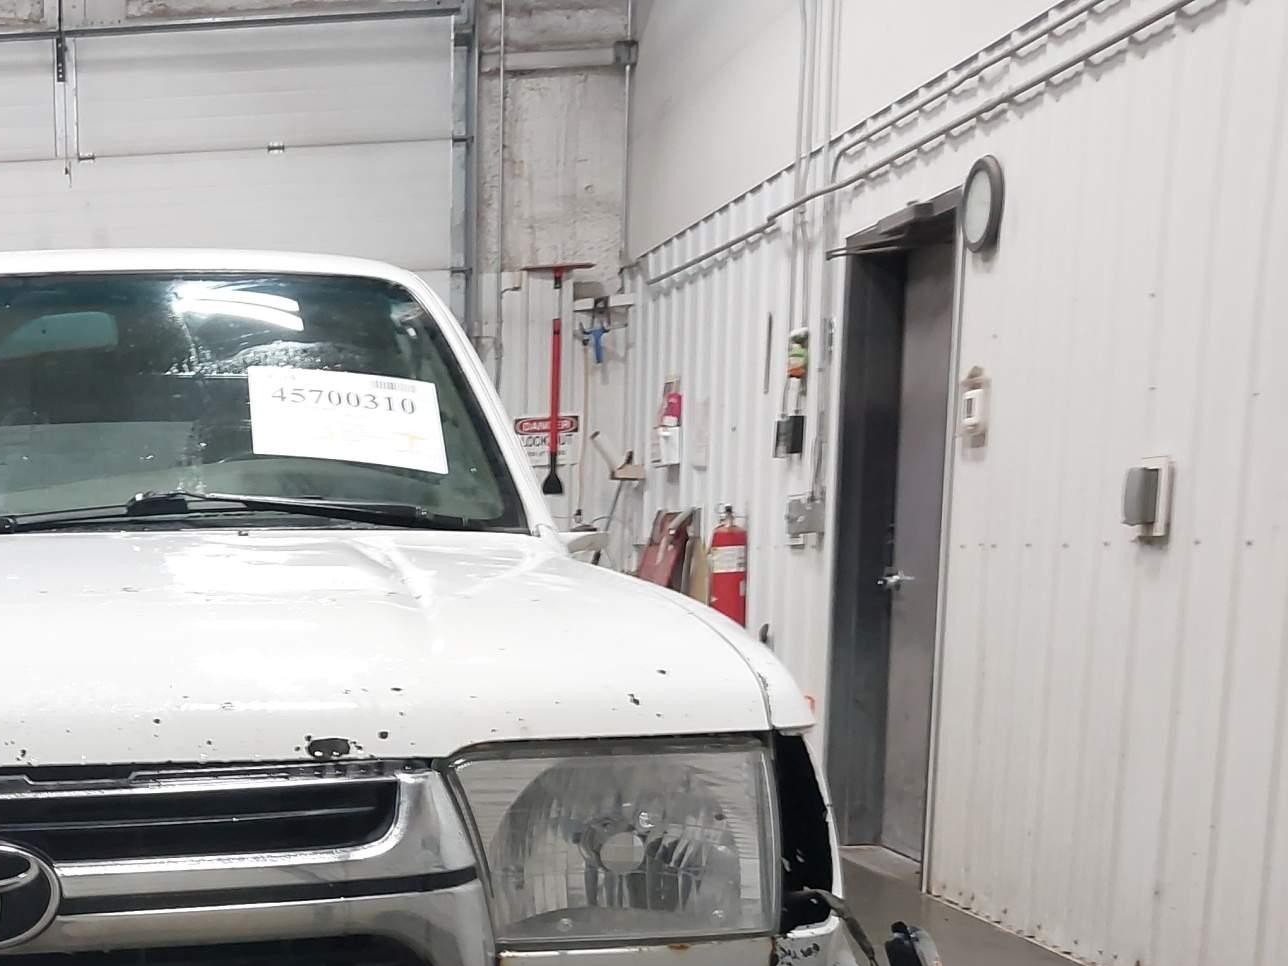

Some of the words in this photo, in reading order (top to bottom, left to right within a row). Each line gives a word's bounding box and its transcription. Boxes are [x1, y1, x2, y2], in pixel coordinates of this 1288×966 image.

[271, 386, 416, 415] 45700310
[521, 419, 572, 432] DANER
[521, 433, 574, 448] LOCKUT
